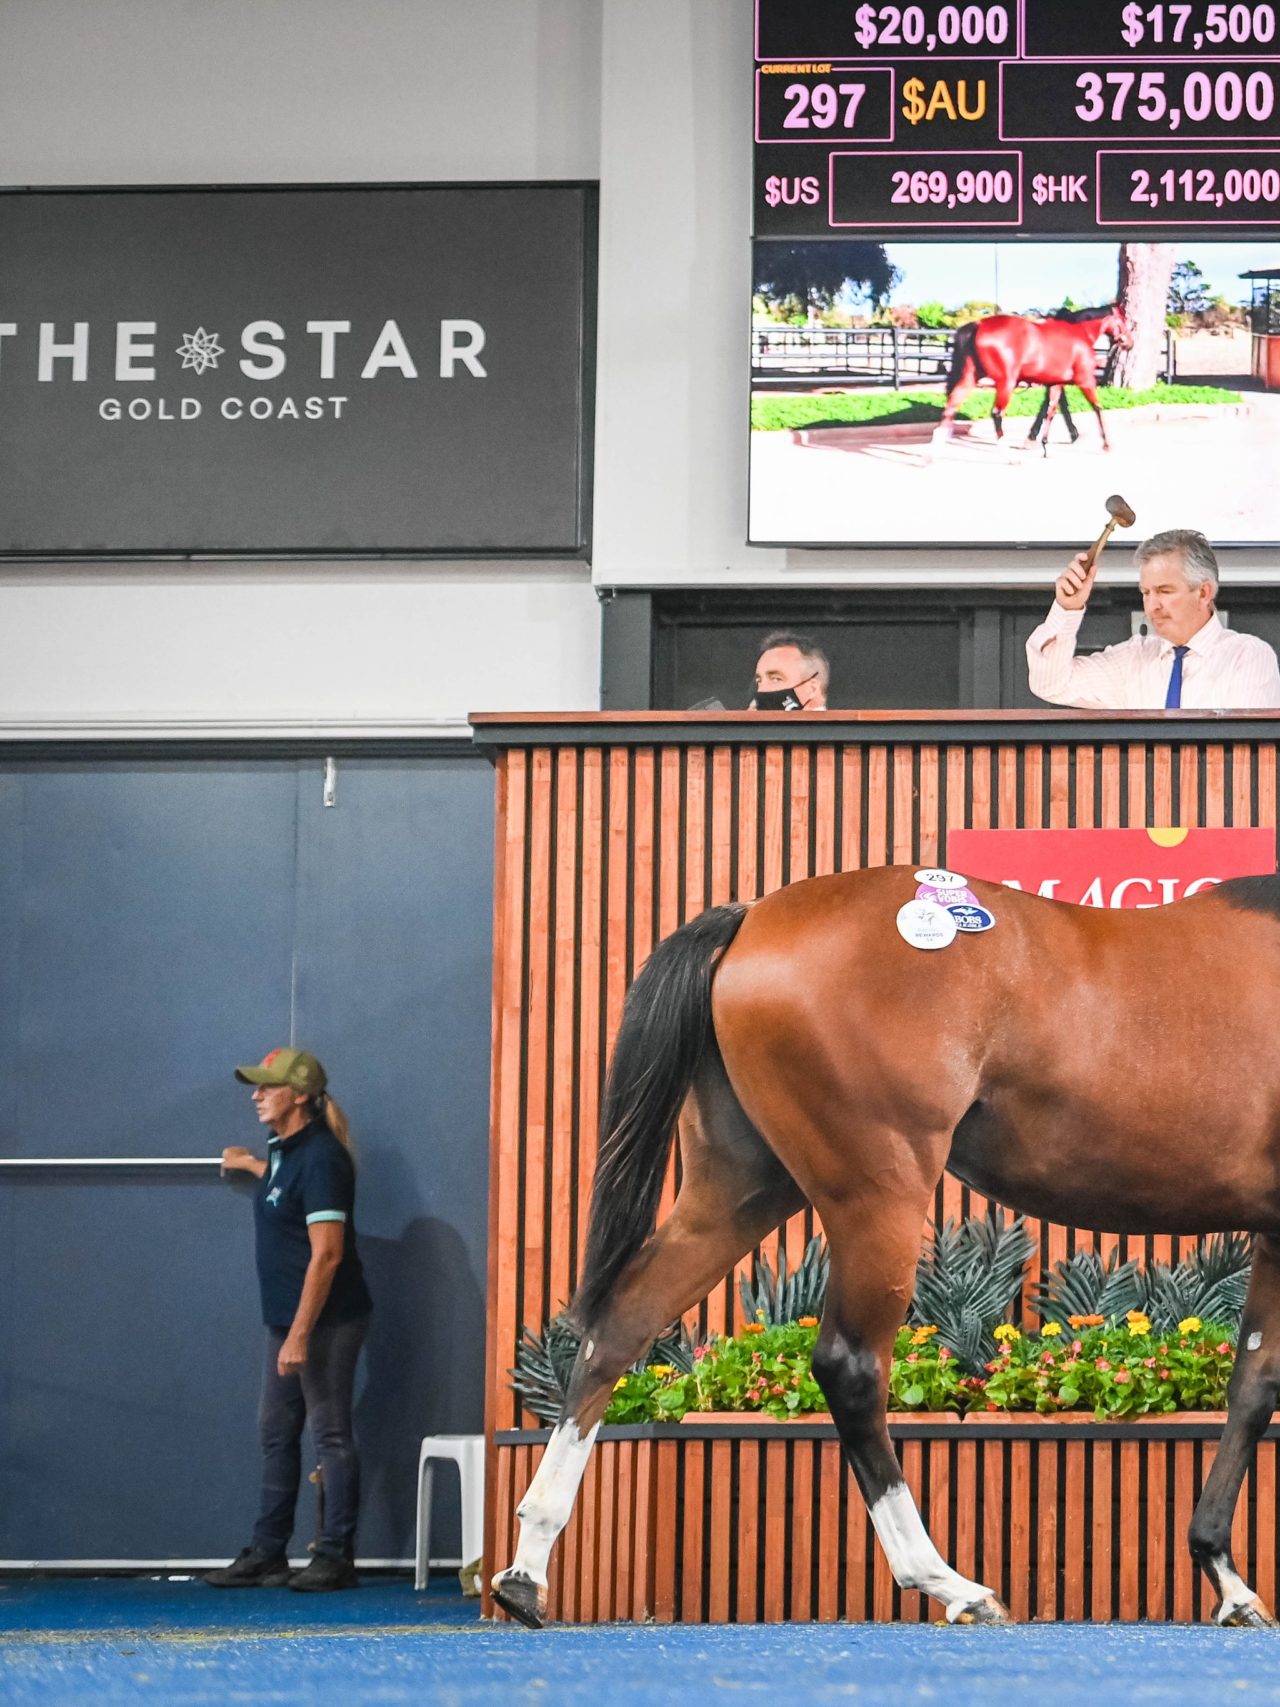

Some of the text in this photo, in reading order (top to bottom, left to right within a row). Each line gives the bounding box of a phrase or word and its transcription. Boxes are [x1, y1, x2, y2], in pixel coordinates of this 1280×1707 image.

[855, 4, 1008, 51] $20,000
[1121, 2, 1275, 49] $17,500
[761, 64, 832, 73] CURRENT LOT
[783, 84, 865, 128] 297
[902, 78, 985, 125] $AU
[1076, 71, 1274, 130] 375,000
[765, 170, 1013, 209] $US 269,900
[1032, 169, 1280, 207] $HK 2,112,000
[240, 320, 487, 380] STAR
[99, 397, 347, 420] GOLD COAST
[925, 873, 954, 883] 297
[936, 888, 968, 896] SUPER
[955, 915, 982, 924] BOBS
